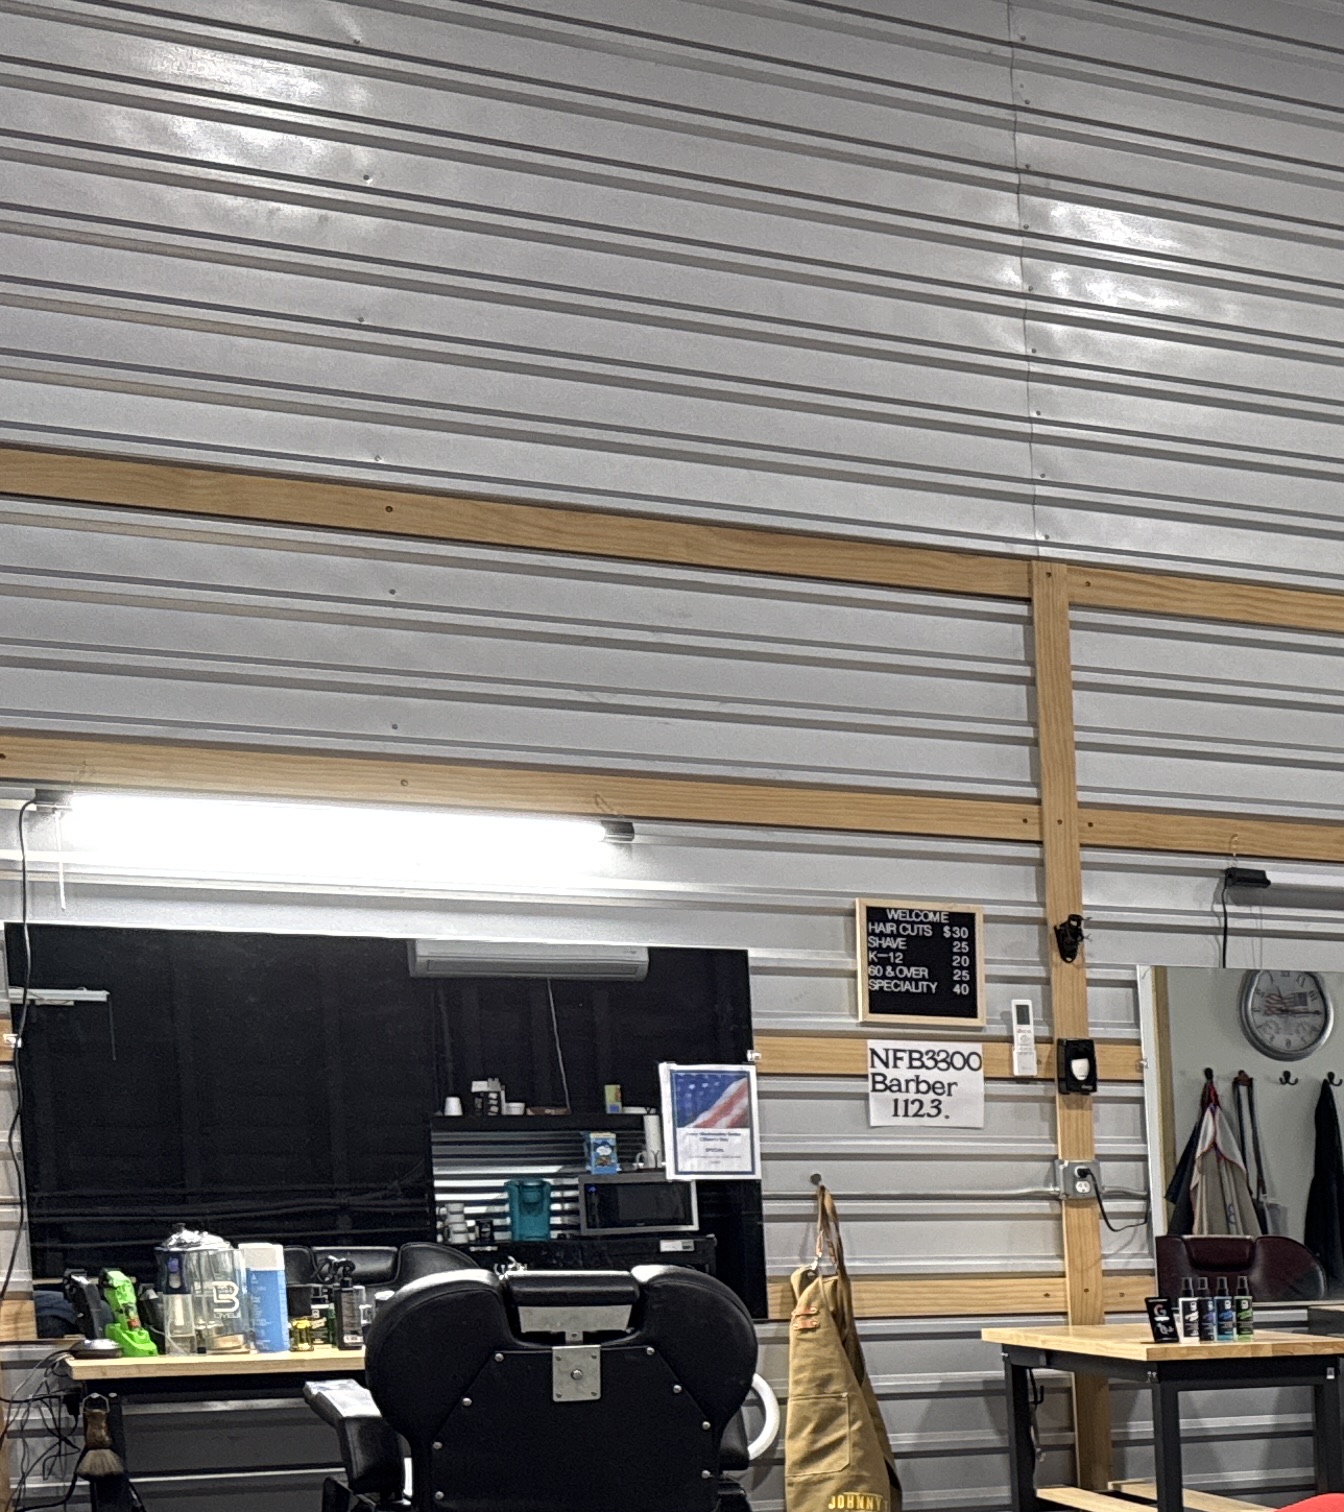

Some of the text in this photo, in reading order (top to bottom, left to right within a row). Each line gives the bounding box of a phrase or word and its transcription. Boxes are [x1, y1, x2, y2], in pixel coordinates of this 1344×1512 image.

[886, 908, 950, 923] WELCOME
[868, 922, 897, 934] HAIR
[899, 923, 933, 937] CUTS
[867, 936, 969, 953] SHAVE 25
[868, 950, 970, 967] K-12 20
[867, 964, 970, 981] 60 & OVER 25
[868, 979, 970, 995] SPECIALITY 40
[869, 1047, 982, 1072] NFB3300
[870, 1072, 958, 1097] Barber
[828, 1494, 882, 1511] JOHNNY
